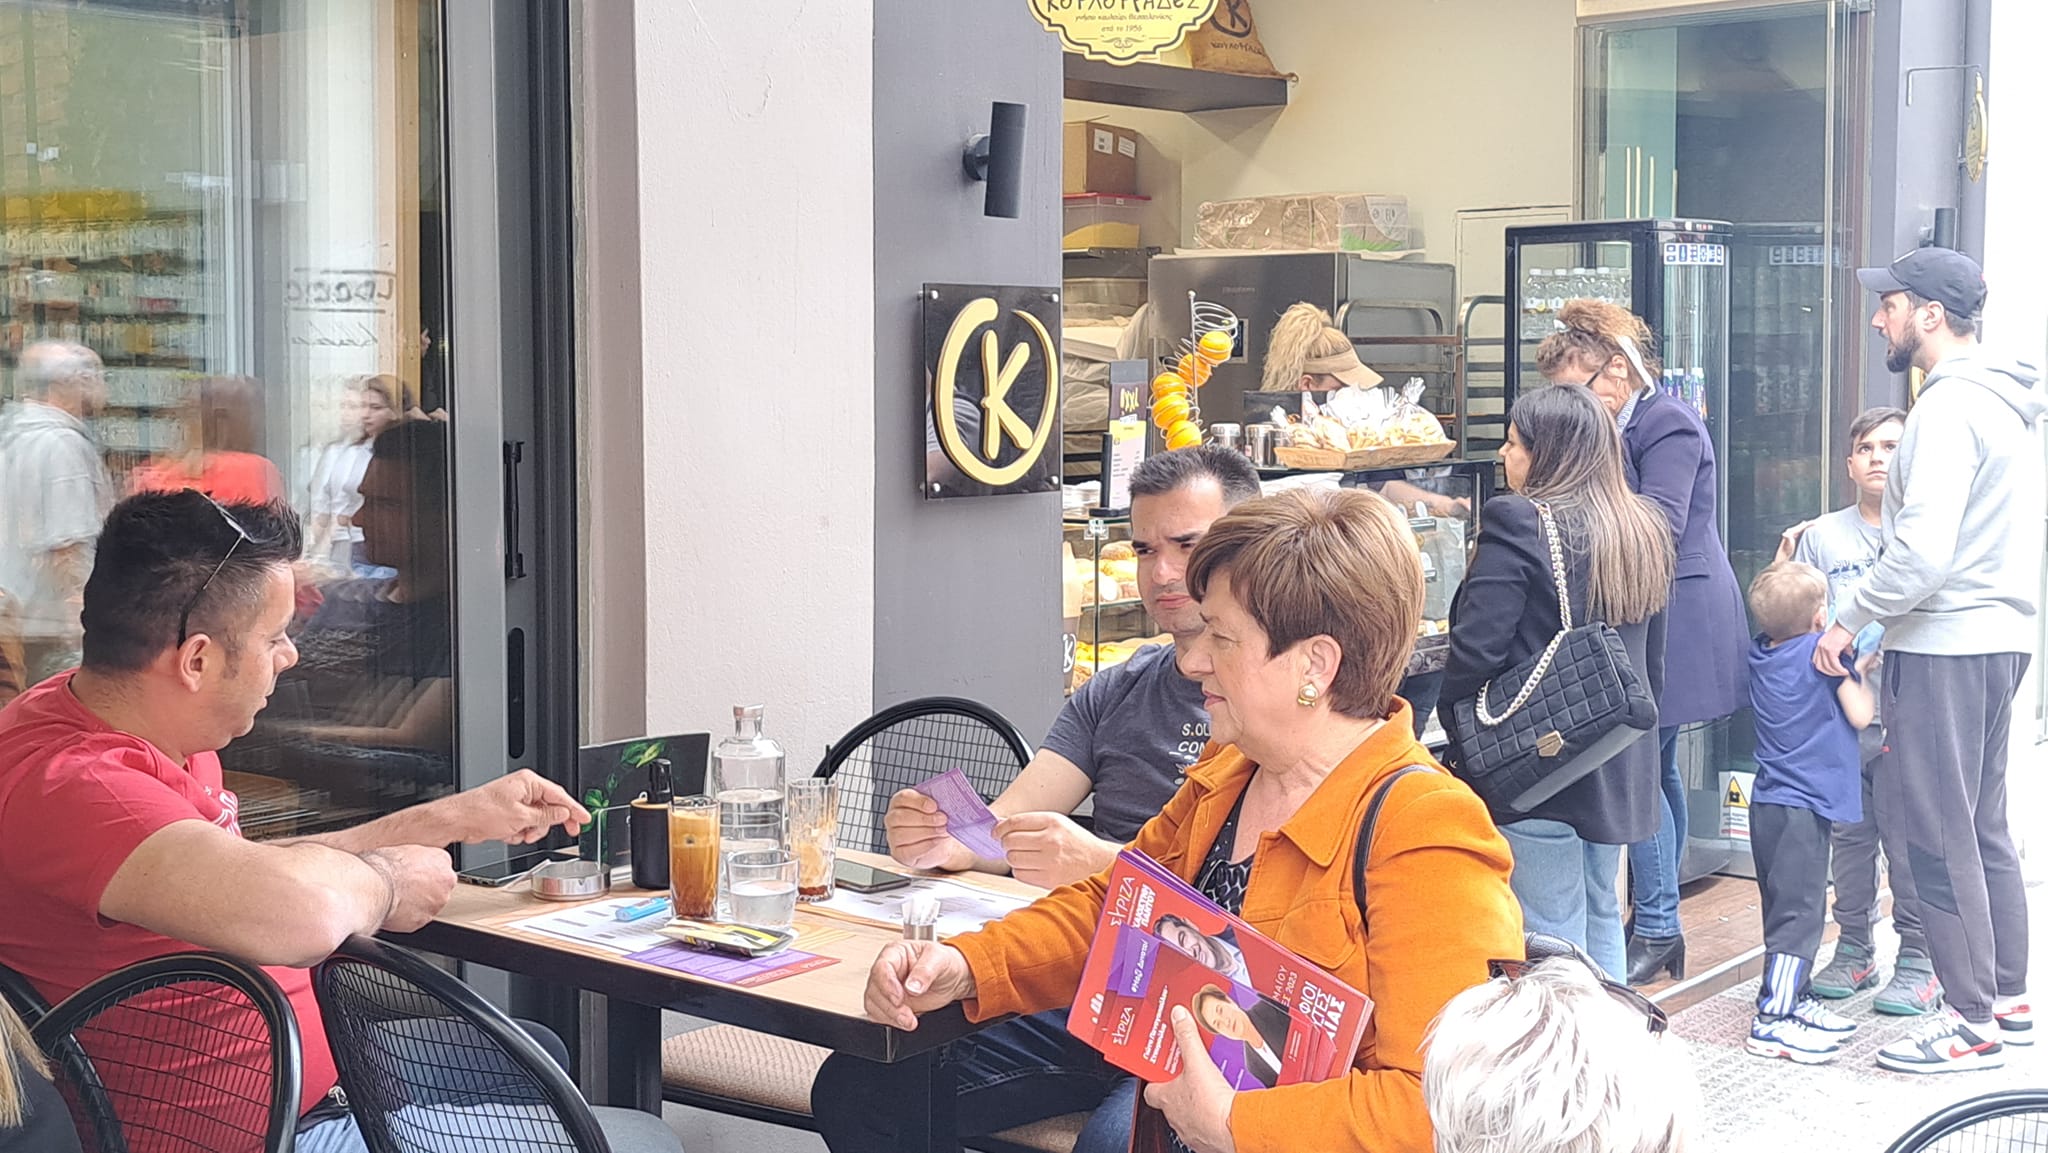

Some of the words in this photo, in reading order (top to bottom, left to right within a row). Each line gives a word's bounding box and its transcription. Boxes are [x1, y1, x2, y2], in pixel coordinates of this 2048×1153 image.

[1107, 877, 1136, 926] ΣΥΡΙΖΑ
[1285, 971, 1298, 994] 2023
[1112, 1007, 1133, 1045] ΣΥΡΙΖΑ
